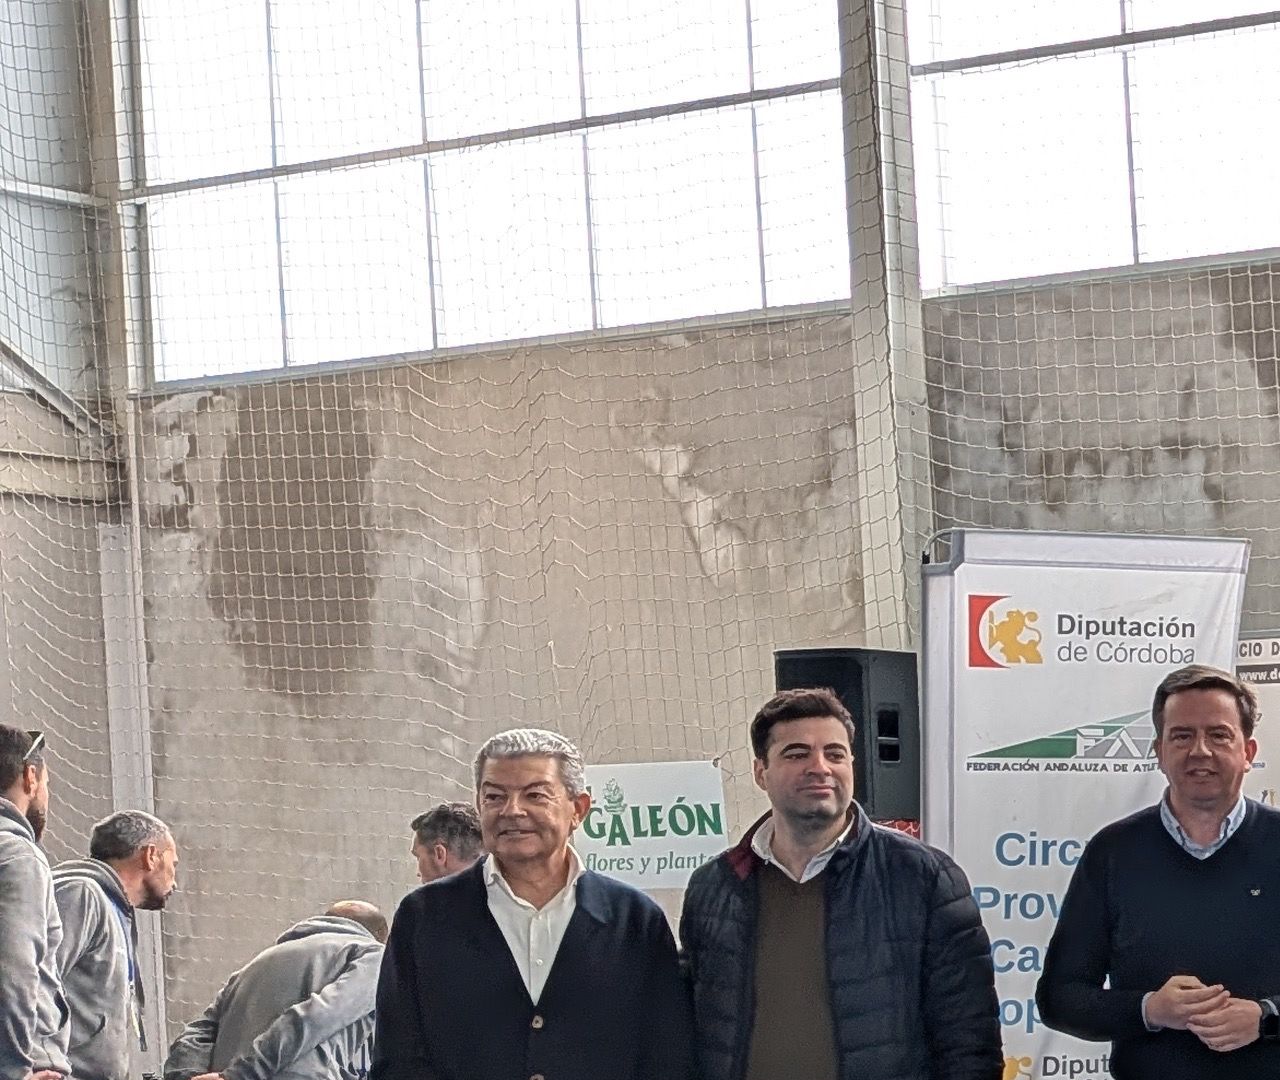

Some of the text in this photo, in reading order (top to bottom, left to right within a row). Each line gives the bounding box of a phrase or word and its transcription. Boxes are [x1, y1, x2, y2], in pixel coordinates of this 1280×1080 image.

[1056, 613, 1196, 641] Diputación
[1057, 641, 1196, 665] de Córdoba
[966, 758, 1040, 772] FEDERACIÓN
[1044, 763, 1109, 773] ANDALUZA
[1113, 763, 1128, 773] DE
[582, 796, 724, 846] GALEÓN
[586, 852, 634, 872] flores
[638, 856, 651, 875] y
